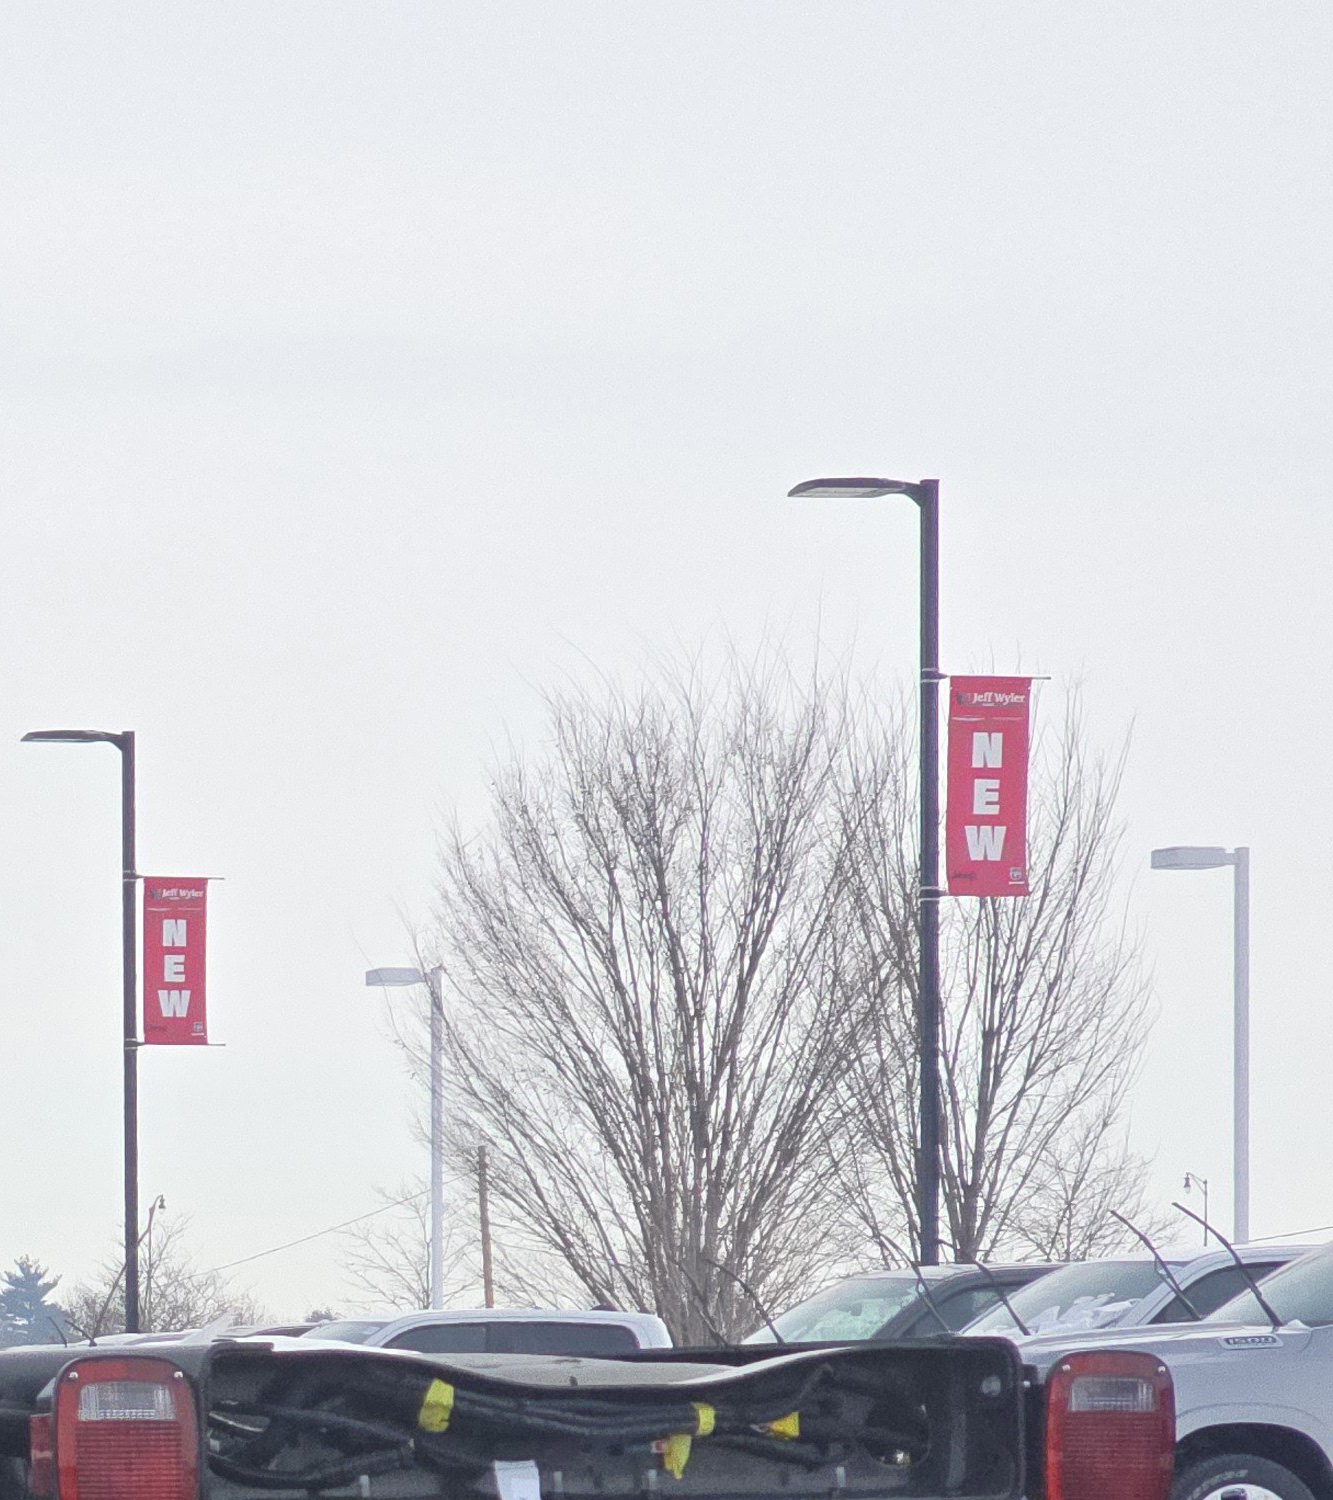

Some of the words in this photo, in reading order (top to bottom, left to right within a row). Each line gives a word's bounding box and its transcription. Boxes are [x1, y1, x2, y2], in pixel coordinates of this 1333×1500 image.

[973, 692, 993, 704] Jeff
[994, 692, 1025, 706] Wyler
[964, 731, 1007, 861] NEW
[157, 919, 191, 1018] NEW
